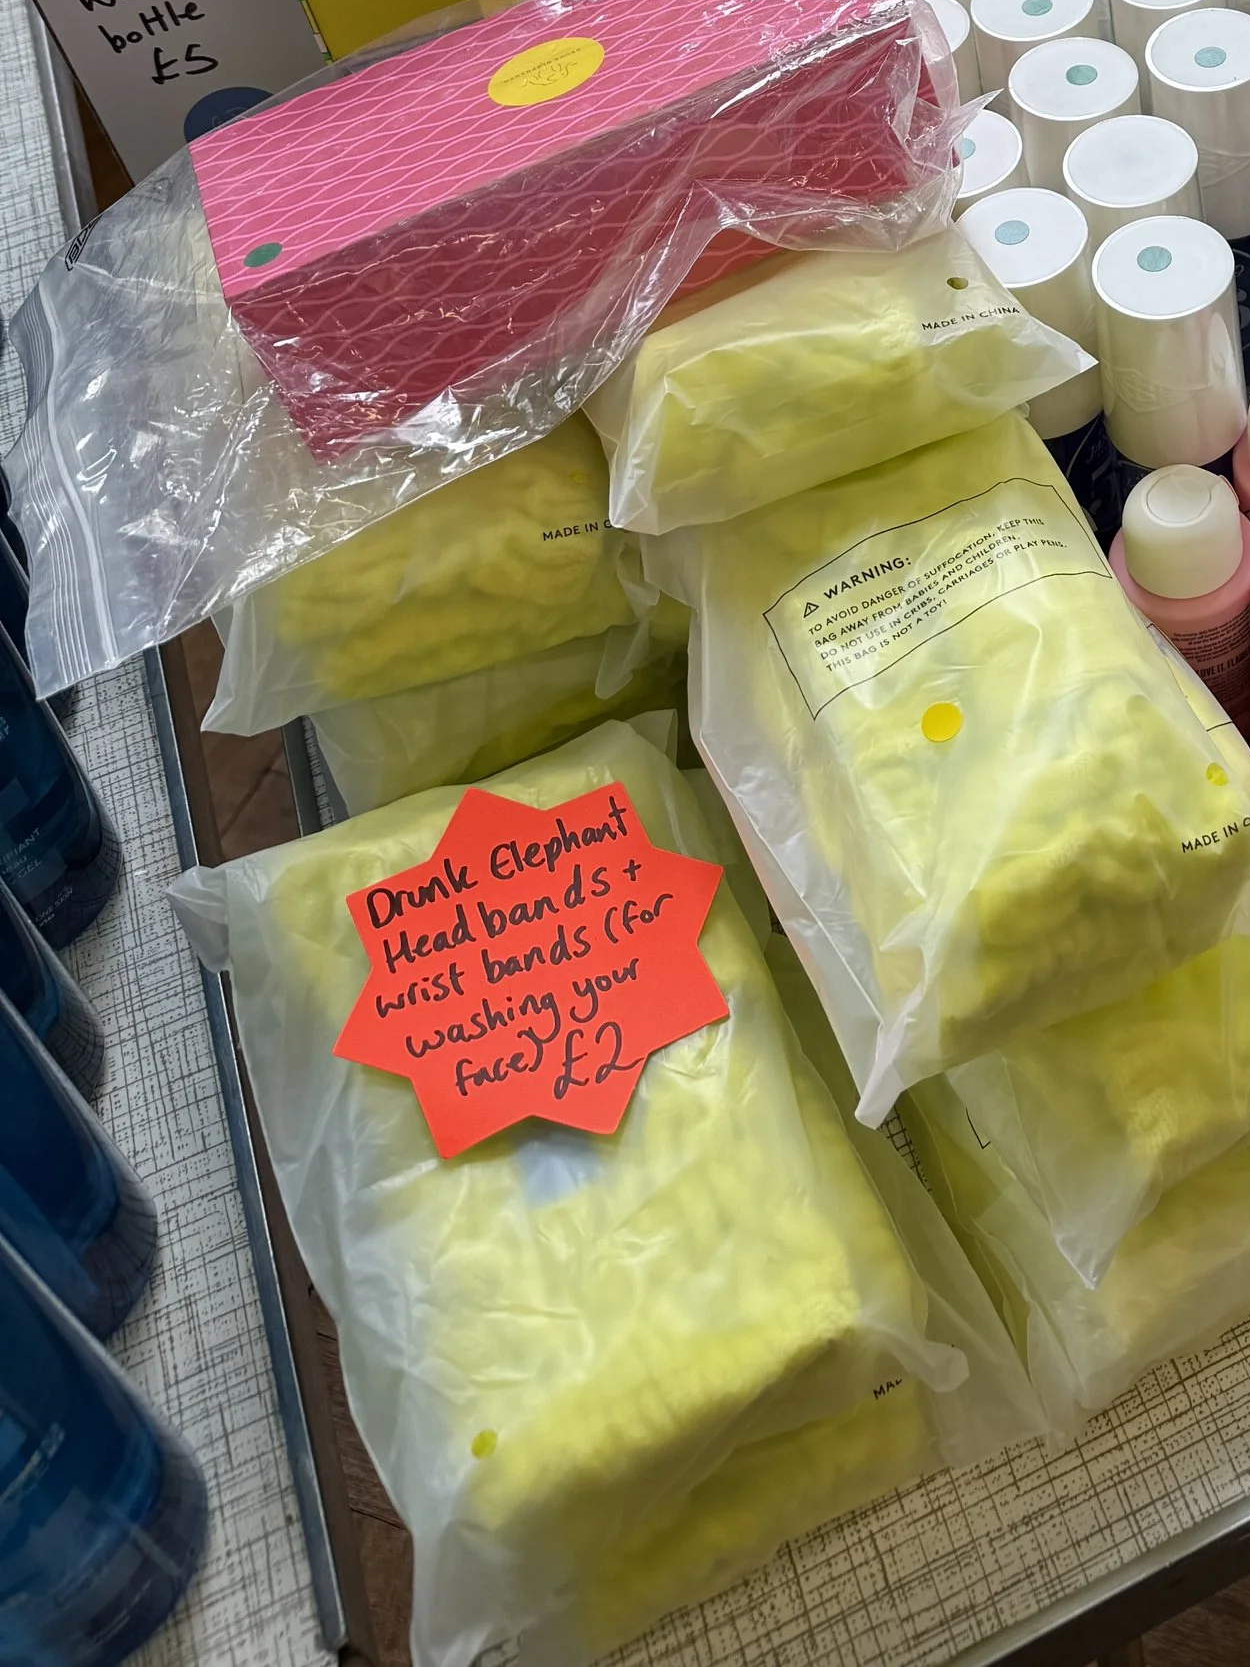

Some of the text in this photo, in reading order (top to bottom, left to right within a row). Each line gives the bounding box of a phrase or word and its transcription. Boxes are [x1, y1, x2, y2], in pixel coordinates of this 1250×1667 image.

[97, 0, 206, 54] bottle
[151, 43, 219, 84] £5
[921, 306, 1020, 331] MADE IN CHINA
[542, 525, 581, 541] MADE
[584, 521, 599, 532] IN
[808, 517, 1045, 637] TO AVOID DANGER OF SUFFOCATION, KEEP THIS
[814, 534, 1021, 649] BAG AWAY FROM BABIES AND CHILDREN.
[820, 537, 1067, 661] DO NOT USE IN CRIBS, CARRIAGES OR PLAY PENS.
[824, 555, 912, 600] WARNING:
[825, 598, 948, 673] THIS BAG IS NOT A TOY!
[365, 796, 628, 931] Drunk Elephant
[622, 860, 642, 882] +
[1181, 822, 1239, 854] MADE IN
[376, 893, 674, 1018] wrist bands (for
[406, 958, 640, 1058] washing your
[455, 1021, 648, 1100] face) £2
